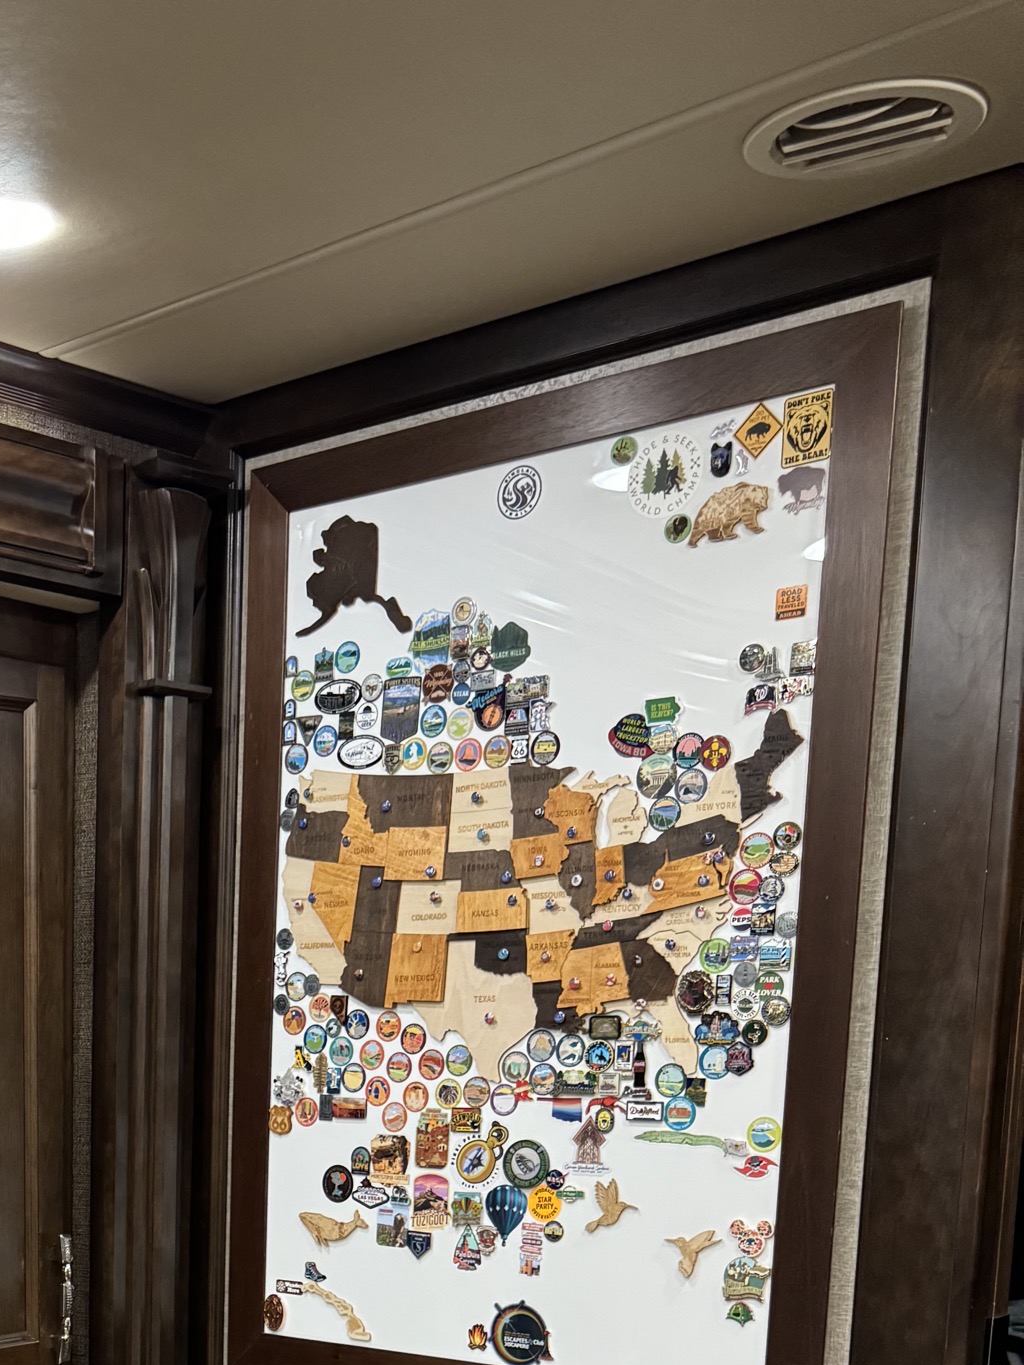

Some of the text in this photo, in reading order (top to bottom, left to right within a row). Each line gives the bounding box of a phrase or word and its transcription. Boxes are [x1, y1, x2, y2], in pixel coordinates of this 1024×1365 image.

[787, 392, 832, 409] DON'T POKE
[634, 441, 657, 470] HIDE
[674, 434, 698, 455] SEEK
[784, 448, 828, 465] THE BEAR!
[630, 472, 699, 515] WORLD CHAMP
[781, 588, 803, 598] ROAD
[781, 595, 801, 604] LESS
[510, 648, 526, 656] HILLS
[658, 702, 671, 710] THIS
[514, 746, 525, 756] 66
[632, 746, 647, 756] 80
[455, 780, 507, 794] NORTH DAKOTA
[696, 801, 736, 812] NEW YORK
[548, 809, 585, 818] WISCONSIN
[482, 820, 509, 830] DAKOTA
[353, 846, 375, 855] IDAHO
[398, 848, 432, 857] WYOMING
[527, 846, 548, 854] IOWA
[531, 891, 566, 900] MISSOURI
[323, 900, 349, 909] NEVADA
[602, 903, 642, 913] KENTUCKY
[411, 912, 447, 922] COLORADO
[471, 909, 499, 918] KANSAS
[299, 942, 336, 950] CALIFORNIA
[529, 941, 569, 951] ARKANSAS
[394, 974, 436, 983] NEW MEXICO
[759, 976, 780, 984] PARK
[473, 995, 496, 1003] TEXAS
[410, 1214, 450, 1227] TUZIGOOT
